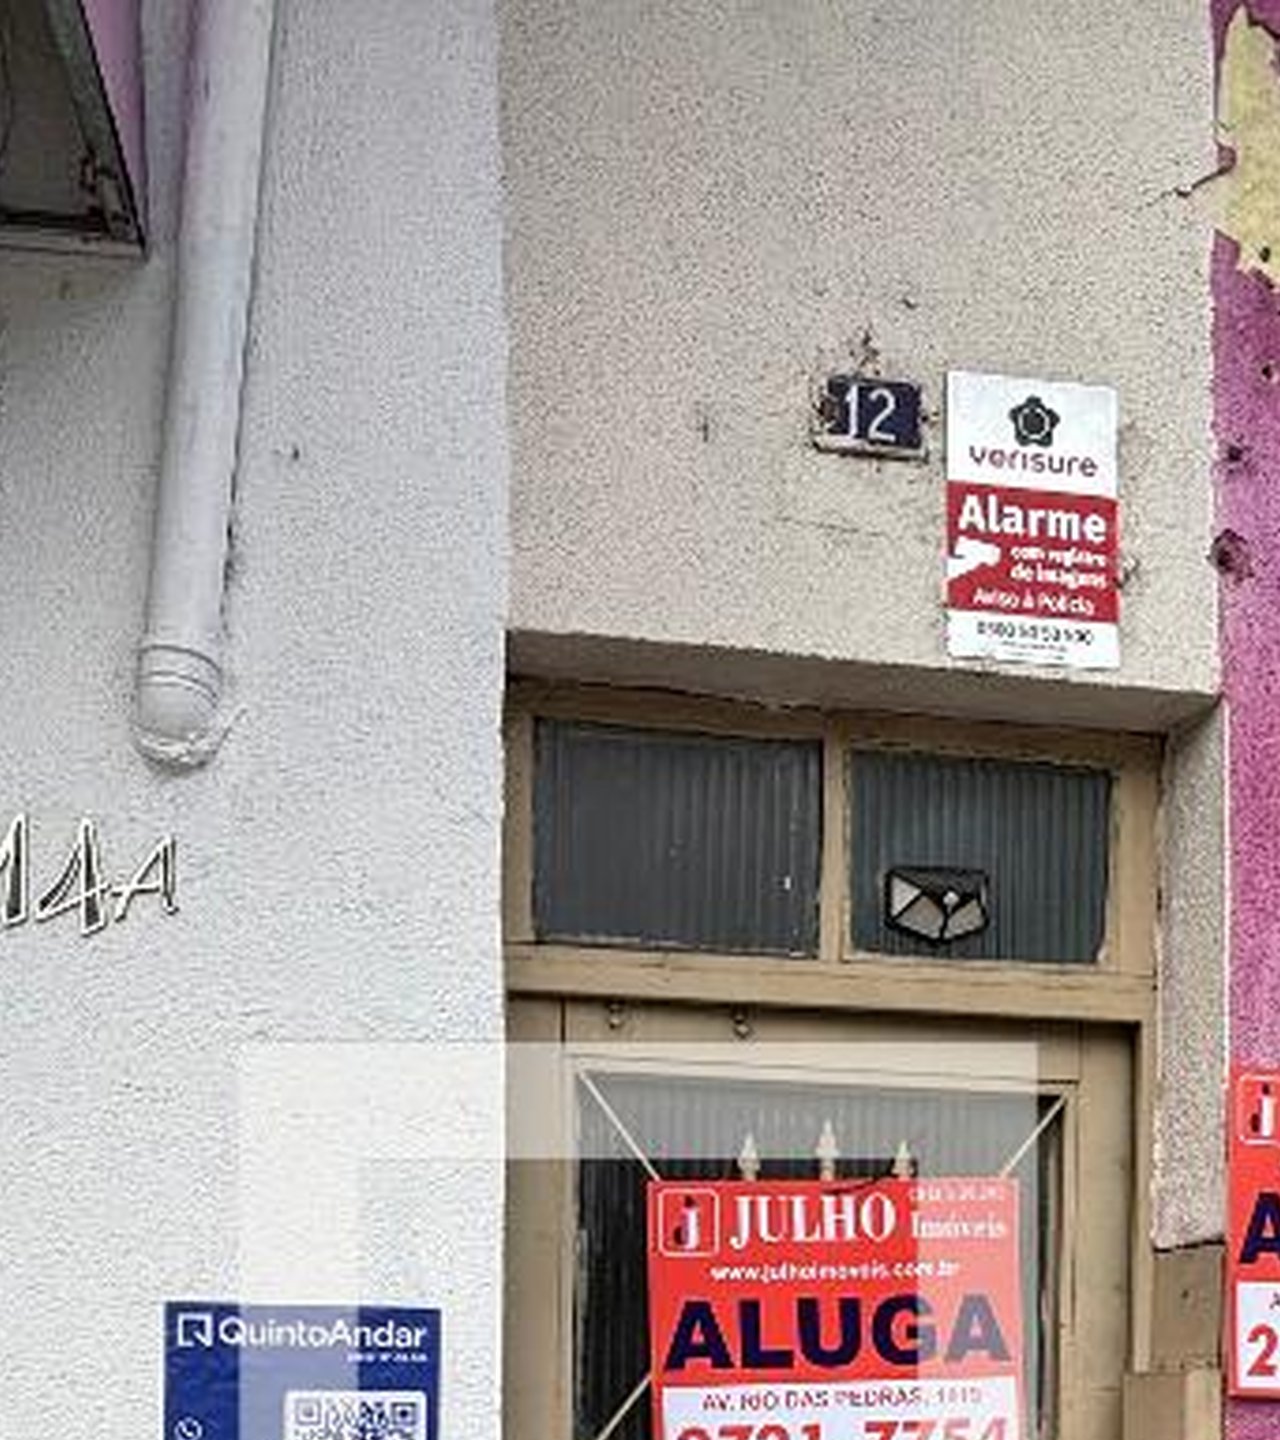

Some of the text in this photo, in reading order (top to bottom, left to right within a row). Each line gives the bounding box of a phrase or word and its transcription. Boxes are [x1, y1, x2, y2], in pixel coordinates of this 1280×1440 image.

[844, 385, 896, 442] 12
[969, 445, 1099, 478] verisure
[958, 493, 1107, 541] Alarme
[729, 1193, 897, 1249] JULHO
[220, 1317, 427, 1348] QuintoAndar
[665, 1294, 1013, 1370] ALUGA
[784, 1390, 829, 1408] DAS
